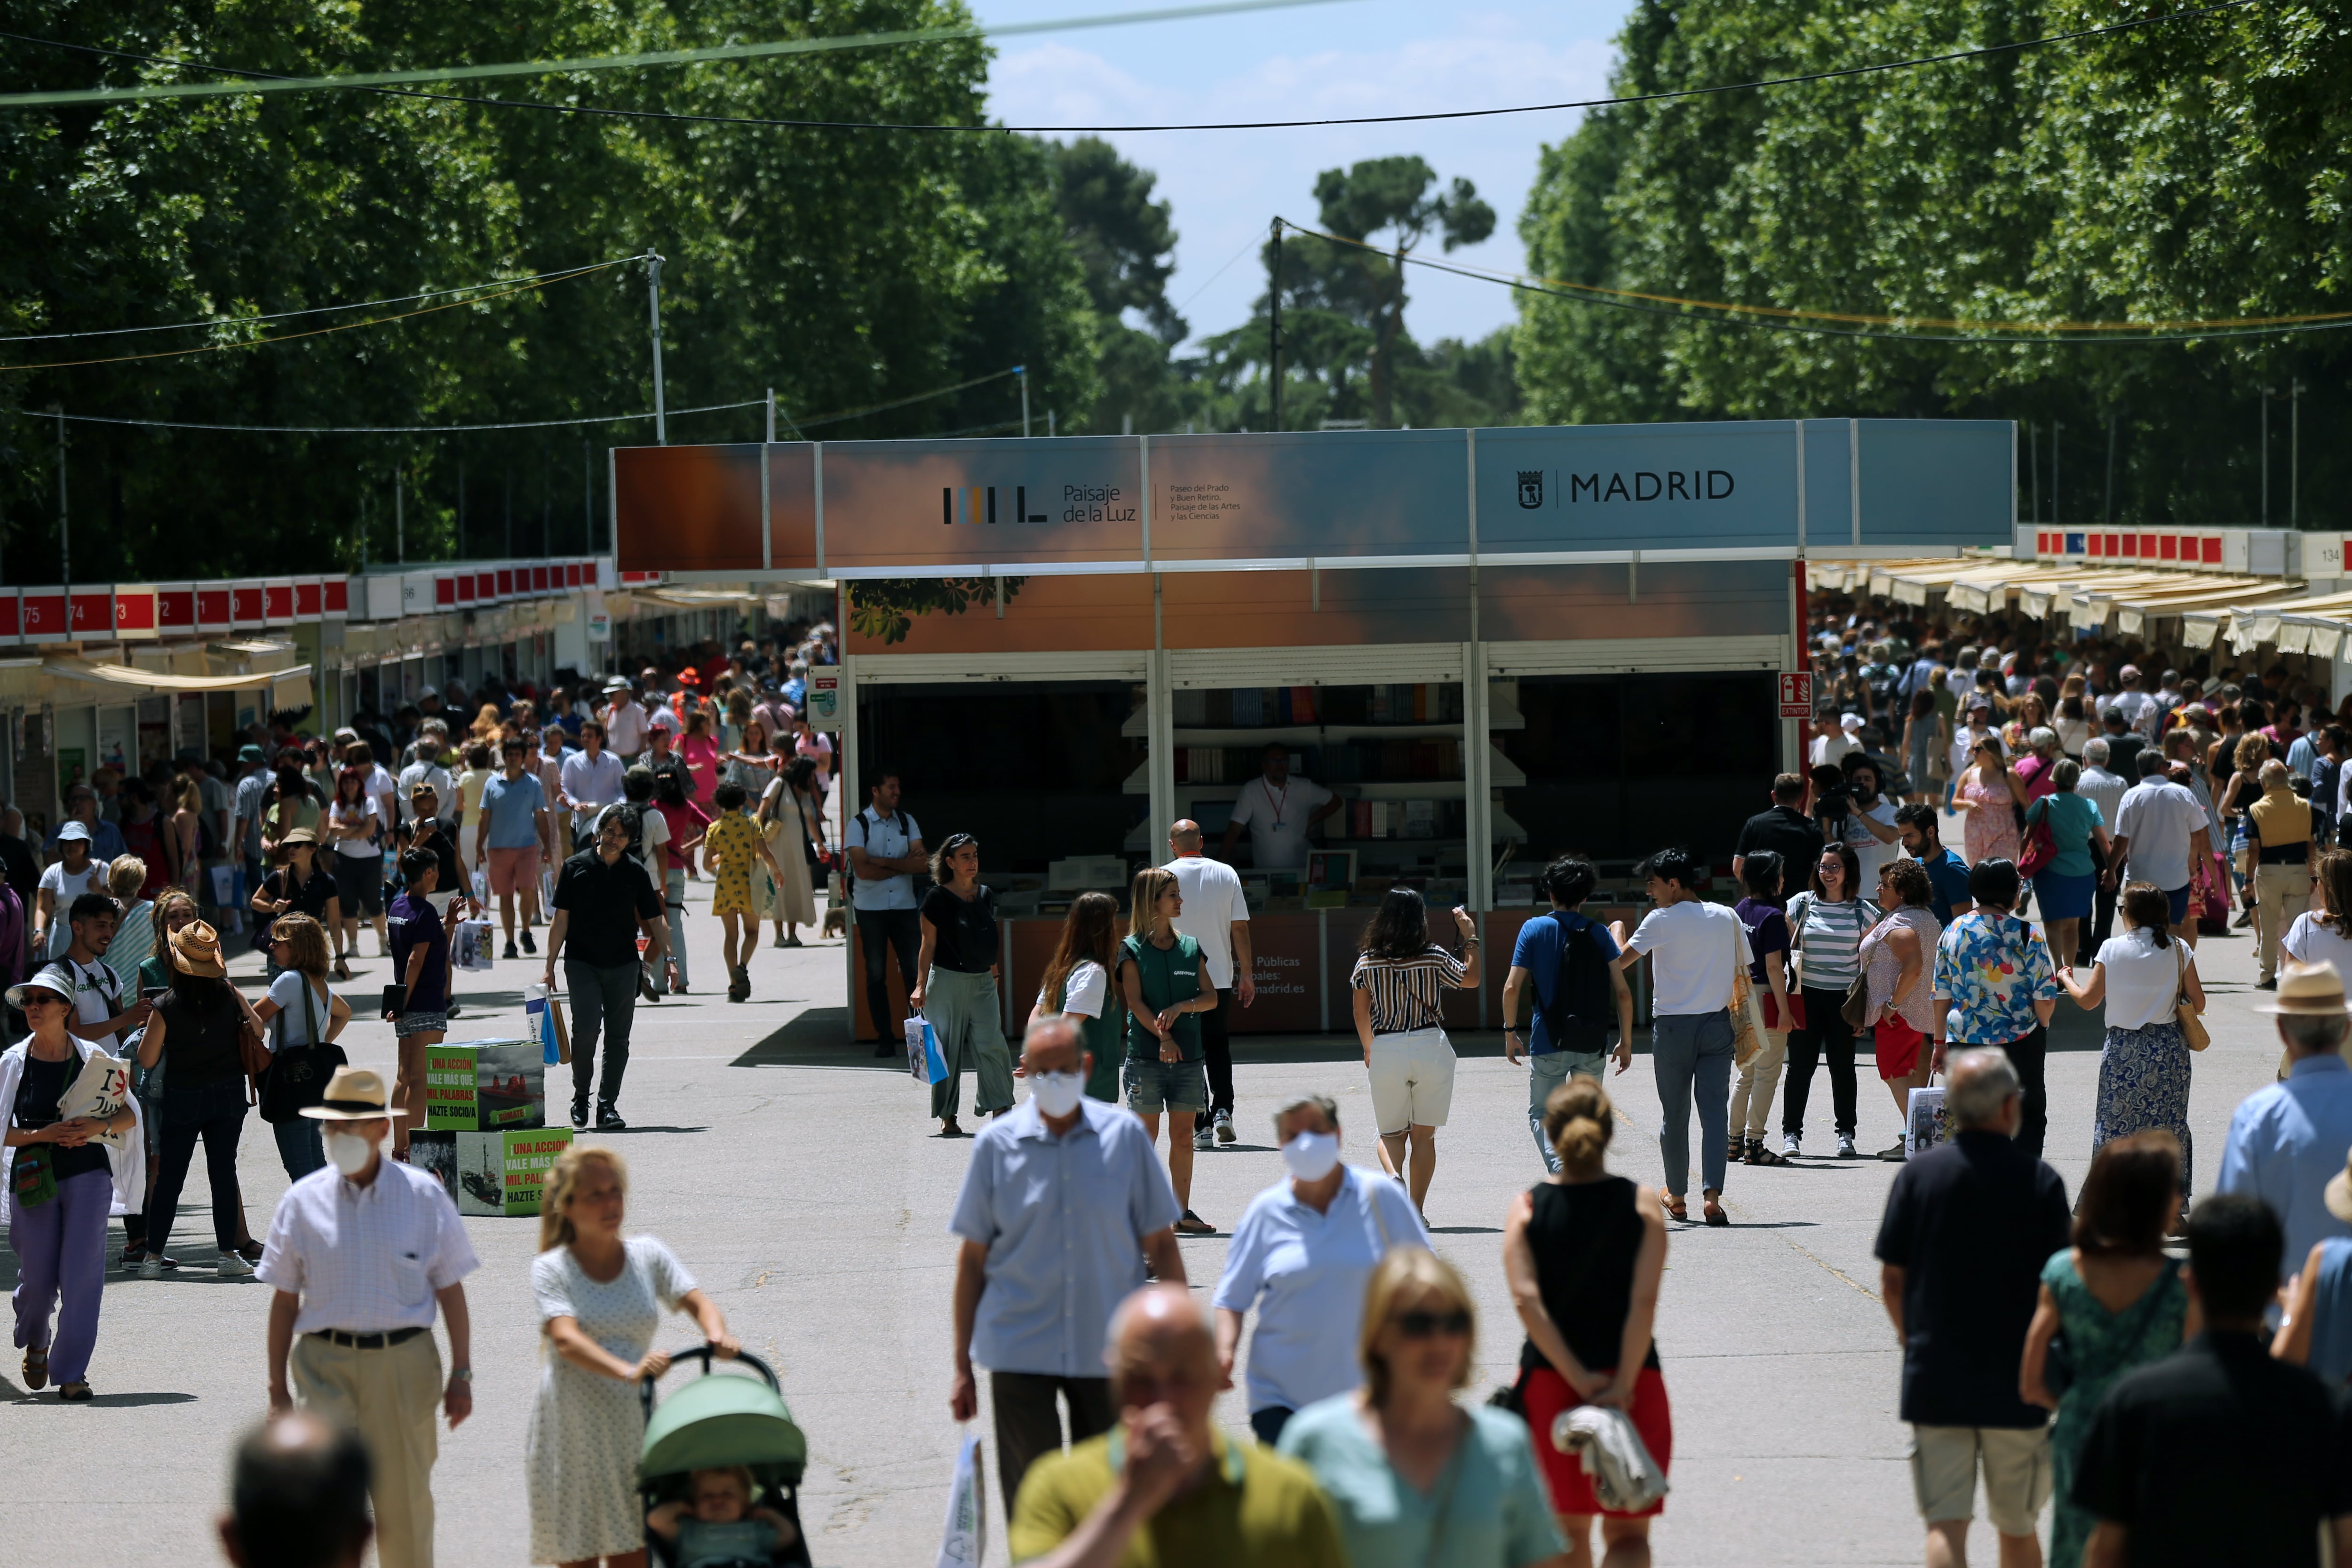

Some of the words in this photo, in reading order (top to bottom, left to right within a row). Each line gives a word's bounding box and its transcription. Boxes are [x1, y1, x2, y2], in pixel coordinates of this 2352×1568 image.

[1571, 470, 1735, 503] MADRID
[1064, 484, 1120, 506] Paisaje
[1063, 504, 1085, 523] de
[1089, 504, 1102, 522] la
[1107, 505, 1136, 522] Luz
[1171, 503, 1196, 512] Paisaje
[1189, 512, 1220, 520] Ciencias
[2322, 549, 2339, 562] 134
[24, 607, 40, 623] 75
[70, 605, 84, 621] 74
[1256, 956, 1300, 967] Públicas
[430, 1058, 445, 1070] ¡UNA
[447, 1057, 472, 1070] ACCIÓN
[427, 1073, 442, 1084] VALE
[444, 1072, 459, 1085] MÁS
[460, 1074, 473, 1086] QUE
[427, 1088, 438, 1100] MIL
[440, 1089, 476, 1101] PALABRAS!
[428, 1105, 448, 1117] HAZTE
[450, 1106, 476, 1118] SOCIO/A
[496, 1108, 527, 1124] ¡SÚMATE!
[510, 1142, 532, 1156] ¡UNA
[535, 1138, 568, 1153] ACCIÓN
[506, 1158, 527, 1171] VALE
[530, 1154, 550, 1169] MÁS
[506, 1174, 522, 1186] MIL
[524, 1172, 546, 1185] PALA
[507, 1190, 535, 1203] HAZTE
